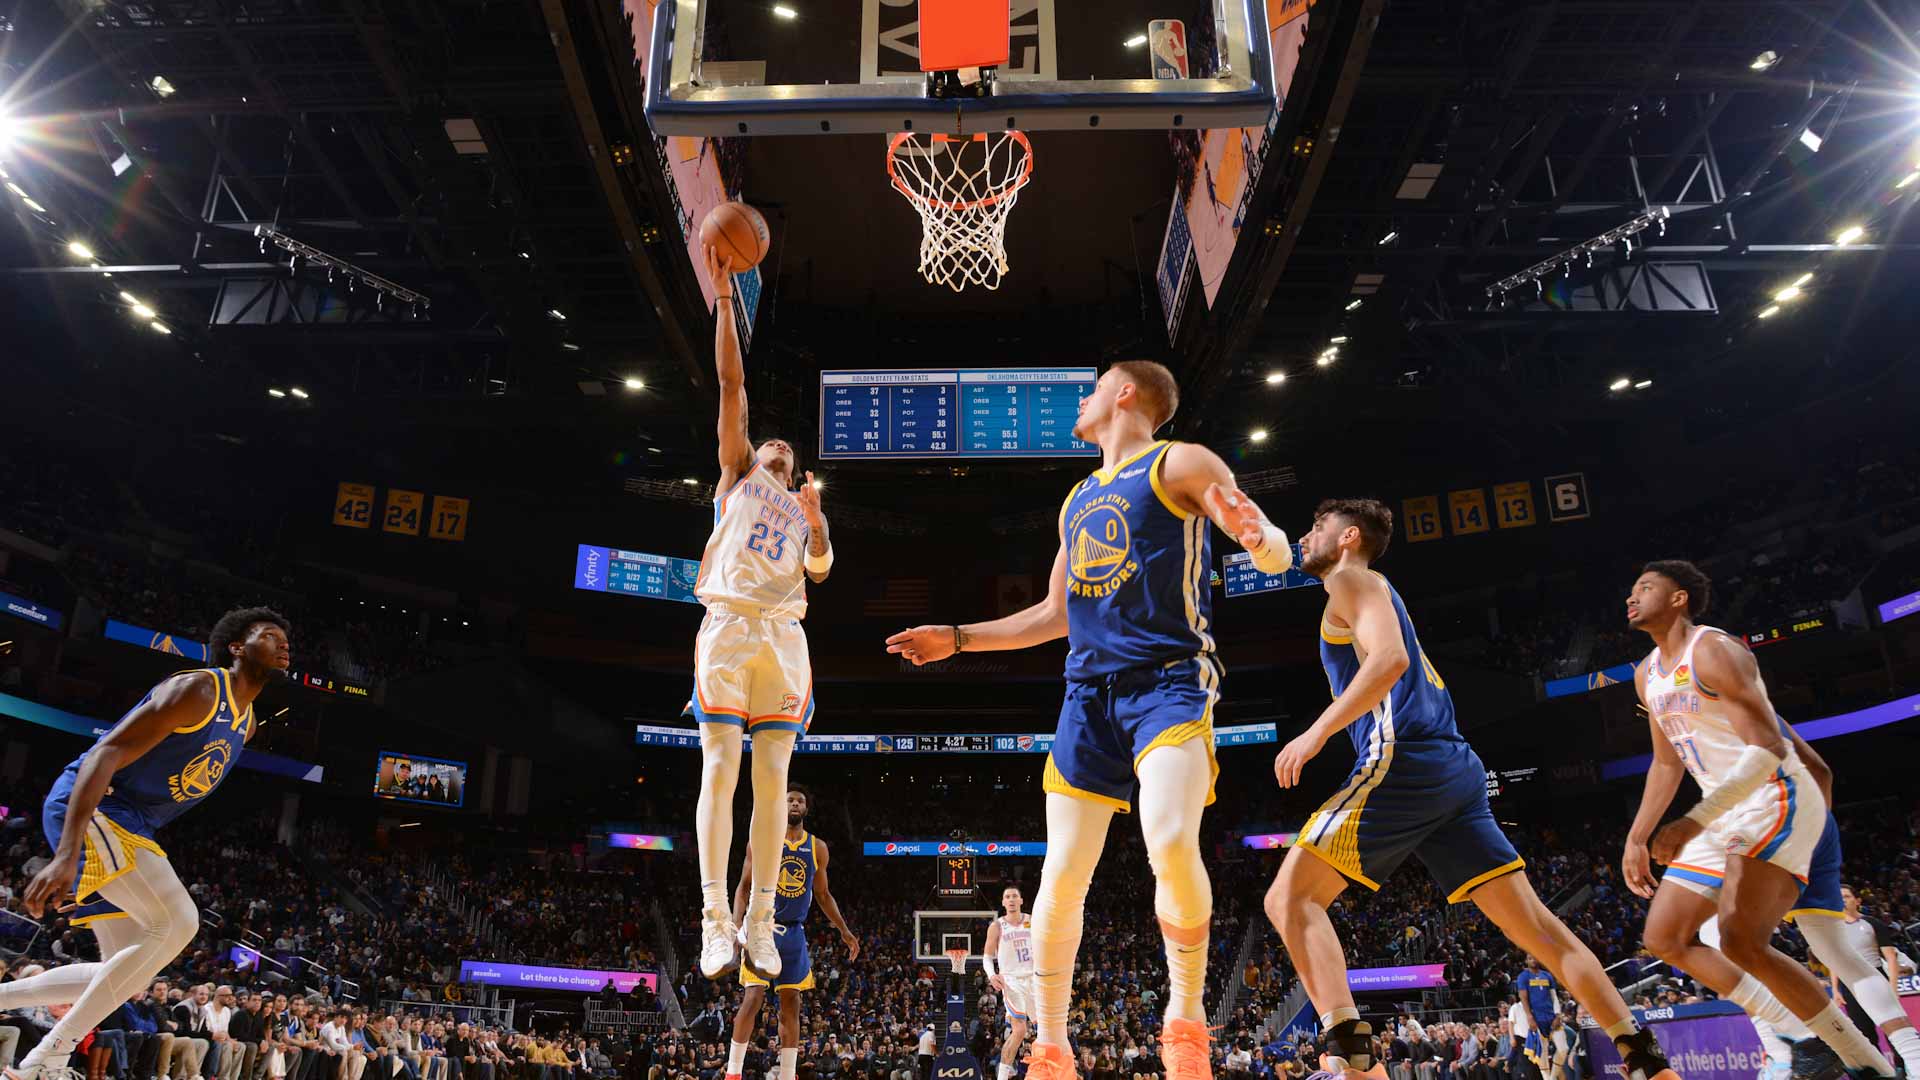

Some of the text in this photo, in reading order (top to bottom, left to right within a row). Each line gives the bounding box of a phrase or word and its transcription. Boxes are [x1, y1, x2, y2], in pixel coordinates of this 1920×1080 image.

[870, 387, 879, 395] 37
[1078, 385, 1083, 393] 3
[874, 420, 879, 428] 5
[1012, 419, 1017, 427] 7
[866, 443, 879, 451] 51.1
[930, 442, 946, 450] 42.9
[1002, 441, 1018, 449] 33.3
[1071, 441, 1085, 449] 71.4
[1555, 482, 1579, 511] 6
[338, 499, 369, 522] 42
[387, 505, 417, 529] 24
[761, 504, 793, 530] CITY
[1069, 494, 1131, 529] GOLDEN STATE
[1455, 505, 1482, 529] 14
[1502, 499, 1528, 522] 13
[437, 512, 462, 535] 17
[1106, 519, 1118, 542] 0
[1410, 512, 1435, 536] 16
[746, 522, 788, 562] 23
[584, 549, 600, 587] xfinity
[1067, 560, 1138, 598] WARRIORS
[8, 603, 47, 621] accenture
[1751, 619, 1824, 642] NJ 5 FINAL
[292, 672, 298, 680] 4
[328, 681, 333, 689] 5
[344, 686, 368, 696] FINAL
[643, 734, 651, 742] 37
[896, 738, 914, 750] 125
[945, 736, 965, 747] 4:27
[996, 738, 1015, 749] 102
[1255, 733, 1269, 741] 71.4
[208, 760, 224, 778] 33
[898, 845, 920, 853] pepsi
[999, 845, 1021, 853] pepsi
[948, 859, 971, 869] 4:27
[793, 869, 804, 879] 22
[951, 870, 968, 885] 11
[1015, 948, 1029, 963] 12
[521, 972, 600, 986] Let there be change
[1350, 976, 1361, 984] Let
[1362, 975, 1380, 983] there
[1391, 974, 1417, 982] change
[1645, 1009, 1668, 1020] CHASE
[1669, 1052, 1685, 1072] et
[1686, 1050, 1725, 1071] there
[1727, 1047, 1745, 1068] be
